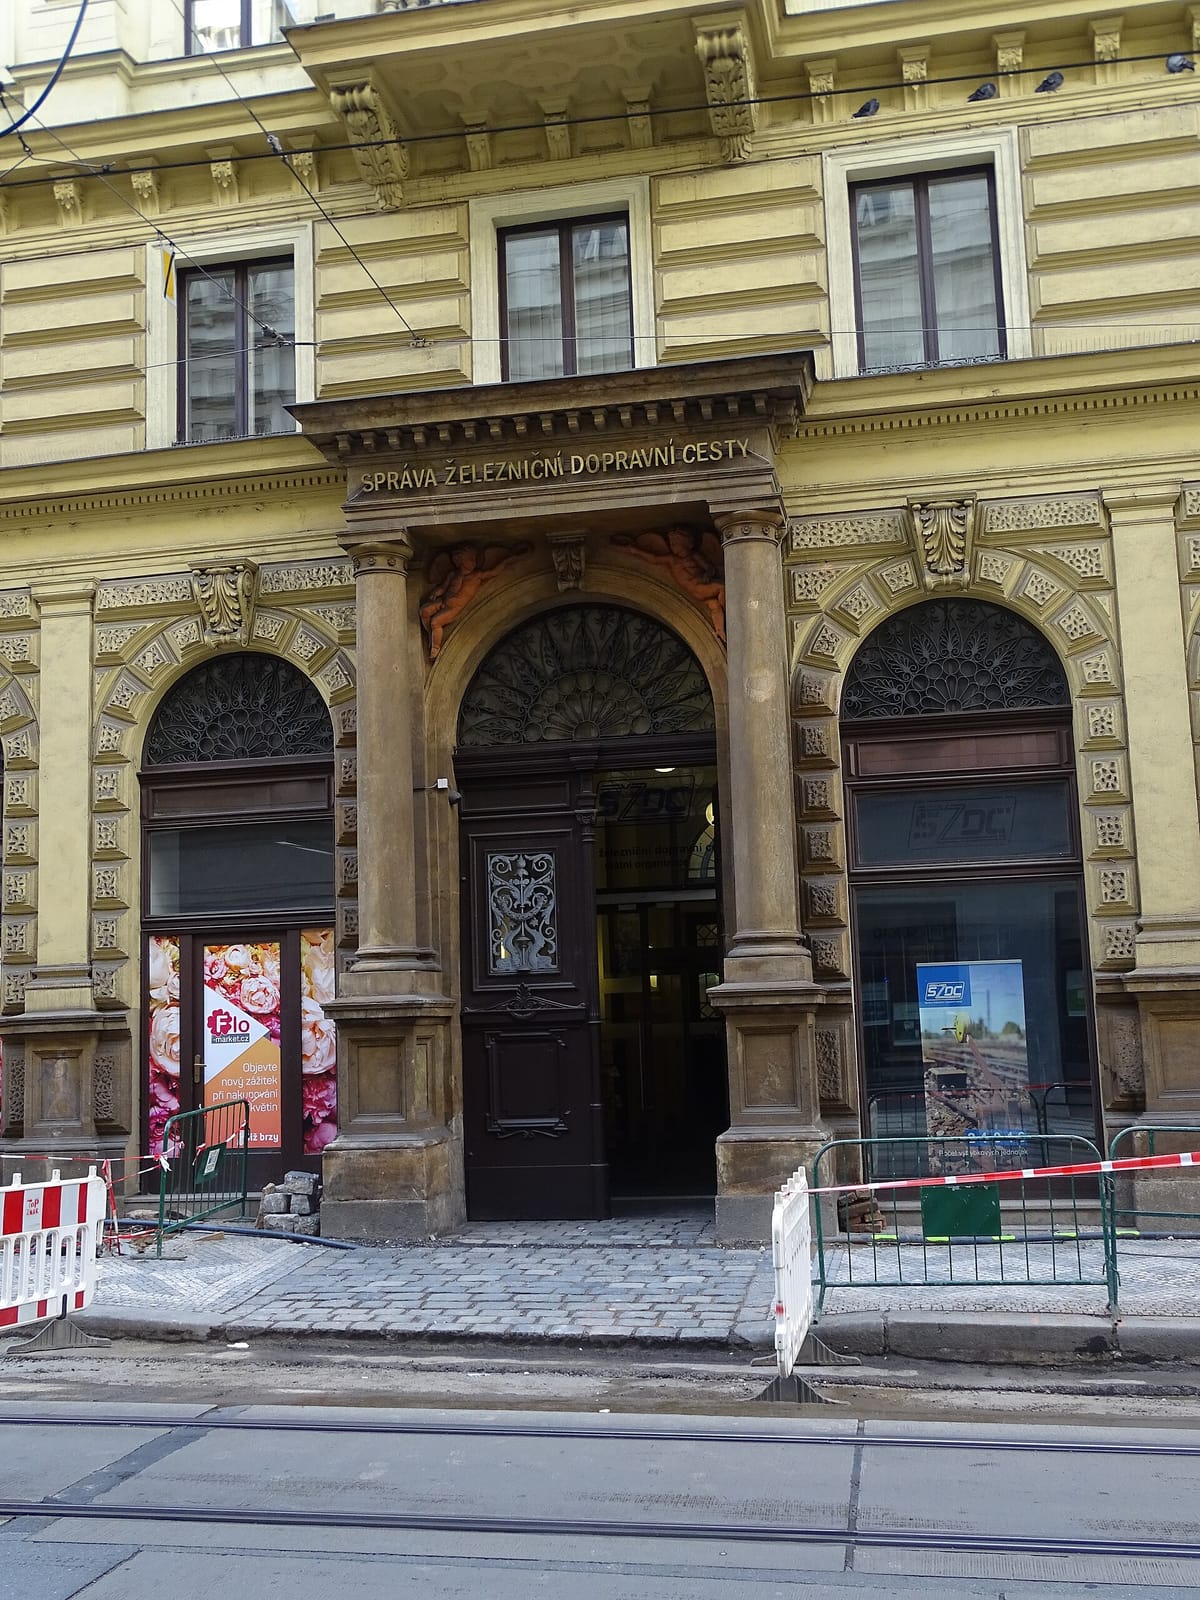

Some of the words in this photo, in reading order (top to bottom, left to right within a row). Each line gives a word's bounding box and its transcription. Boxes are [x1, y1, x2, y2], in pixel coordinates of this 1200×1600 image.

[361, 462, 437, 493] SPRÁVA
[444, 450, 565, 487] ŽELEZNIČNÍ
[571, 438, 677, 476] DOPRAVNÍ
[682, 438, 750, 463] CESTY
[214, 1013, 250, 1034] Flo
[242, 1062, 278, 1074] Objevte
[221, 1076, 245, 1088] nový
[246, 1074, 278, 1086] zážitek
[212, 1090, 224, 1102] při
[250, 1101, 278, 1112] květin
[259, 1132, 279, 1143] brzy
